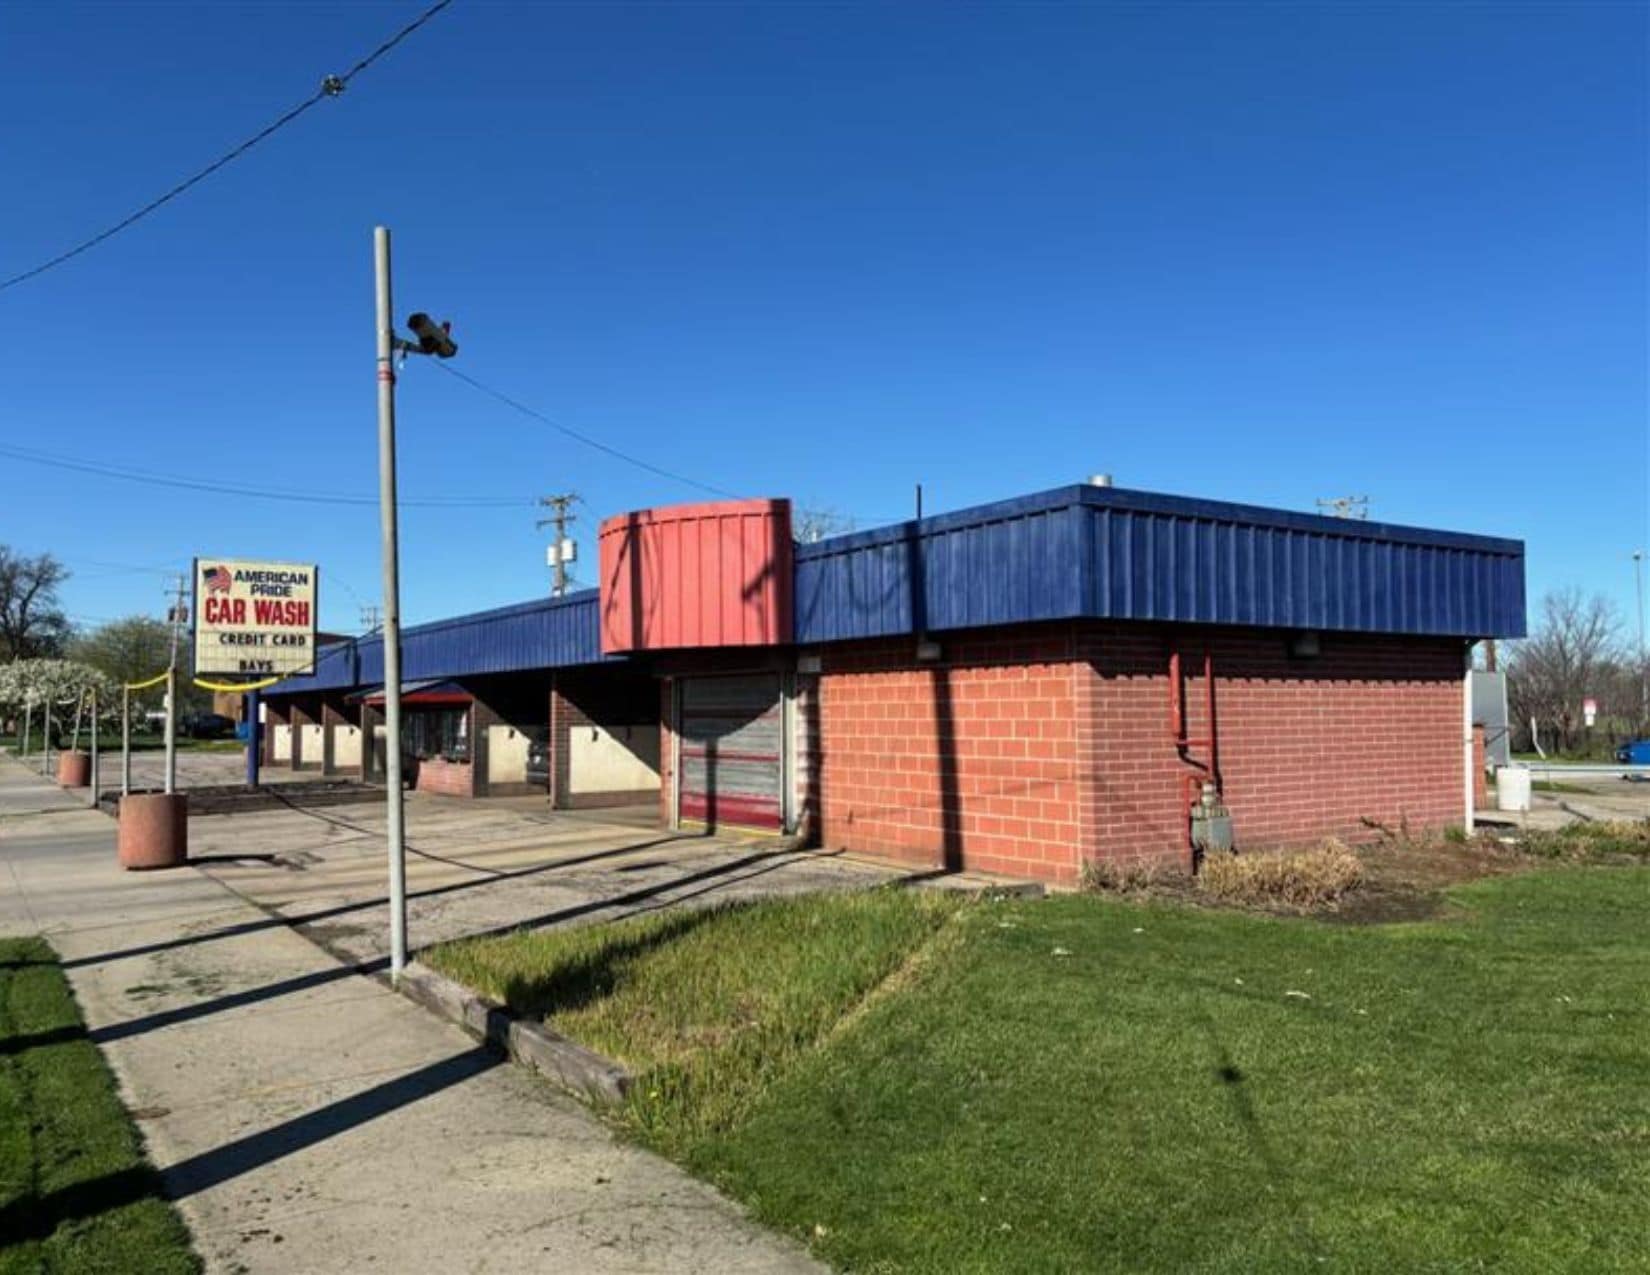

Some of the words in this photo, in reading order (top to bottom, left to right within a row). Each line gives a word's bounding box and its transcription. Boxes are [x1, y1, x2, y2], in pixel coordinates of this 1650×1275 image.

[234, 570, 308, 585] AMERICAN
[250, 583, 292, 597] PRIDE
[205, 598, 246, 624] CAR
[254, 599, 309, 626] WASH
[219, 632, 265, 645] CREDIT
[272, 634, 306, 646] CARD
[239, 660, 273, 672] BAYS
